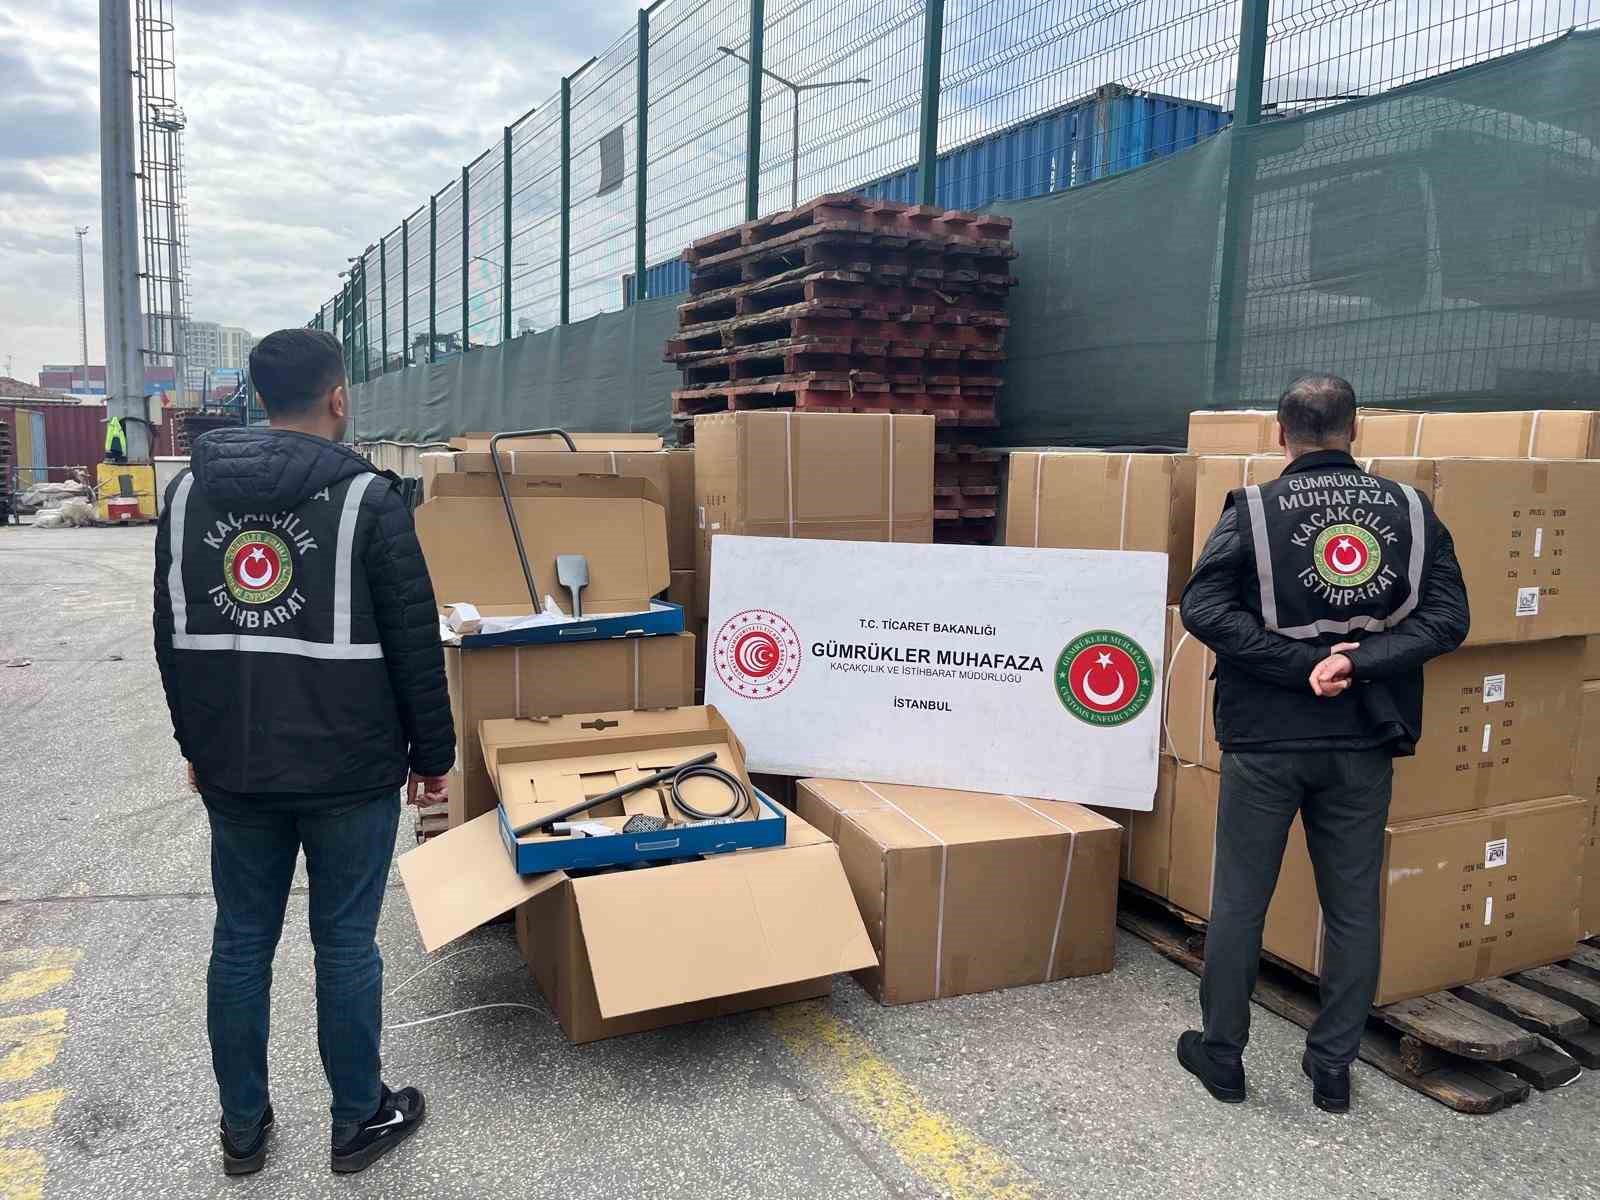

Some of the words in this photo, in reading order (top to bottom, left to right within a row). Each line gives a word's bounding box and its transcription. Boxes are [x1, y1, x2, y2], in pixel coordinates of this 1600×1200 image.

[1288, 472, 1381, 492] GÜMRÜKLER
[1278, 489, 1399, 511] MUHAFAZA
[1290, 506, 1399, 547] KAÇAKÇILIK
[859, 618, 878, 629] T.C.
[882, 618, 930, 632] TİCARET
[933, 622, 996, 636] BAKANLIĞI
[811, 639, 930, 664] GÜMRÜKLER
[936, 649, 1044, 672] MUHAFAZA
[830, 662, 885, 675] KAÇAKÇILIK
[887, 665, 899, 675] VE
[902, 664, 957, 679] İSTİHBARAT
[959, 668, 1022, 684] MÜDÜRLÜĞÜ
[894, 696, 952, 712] İSTANBUL
